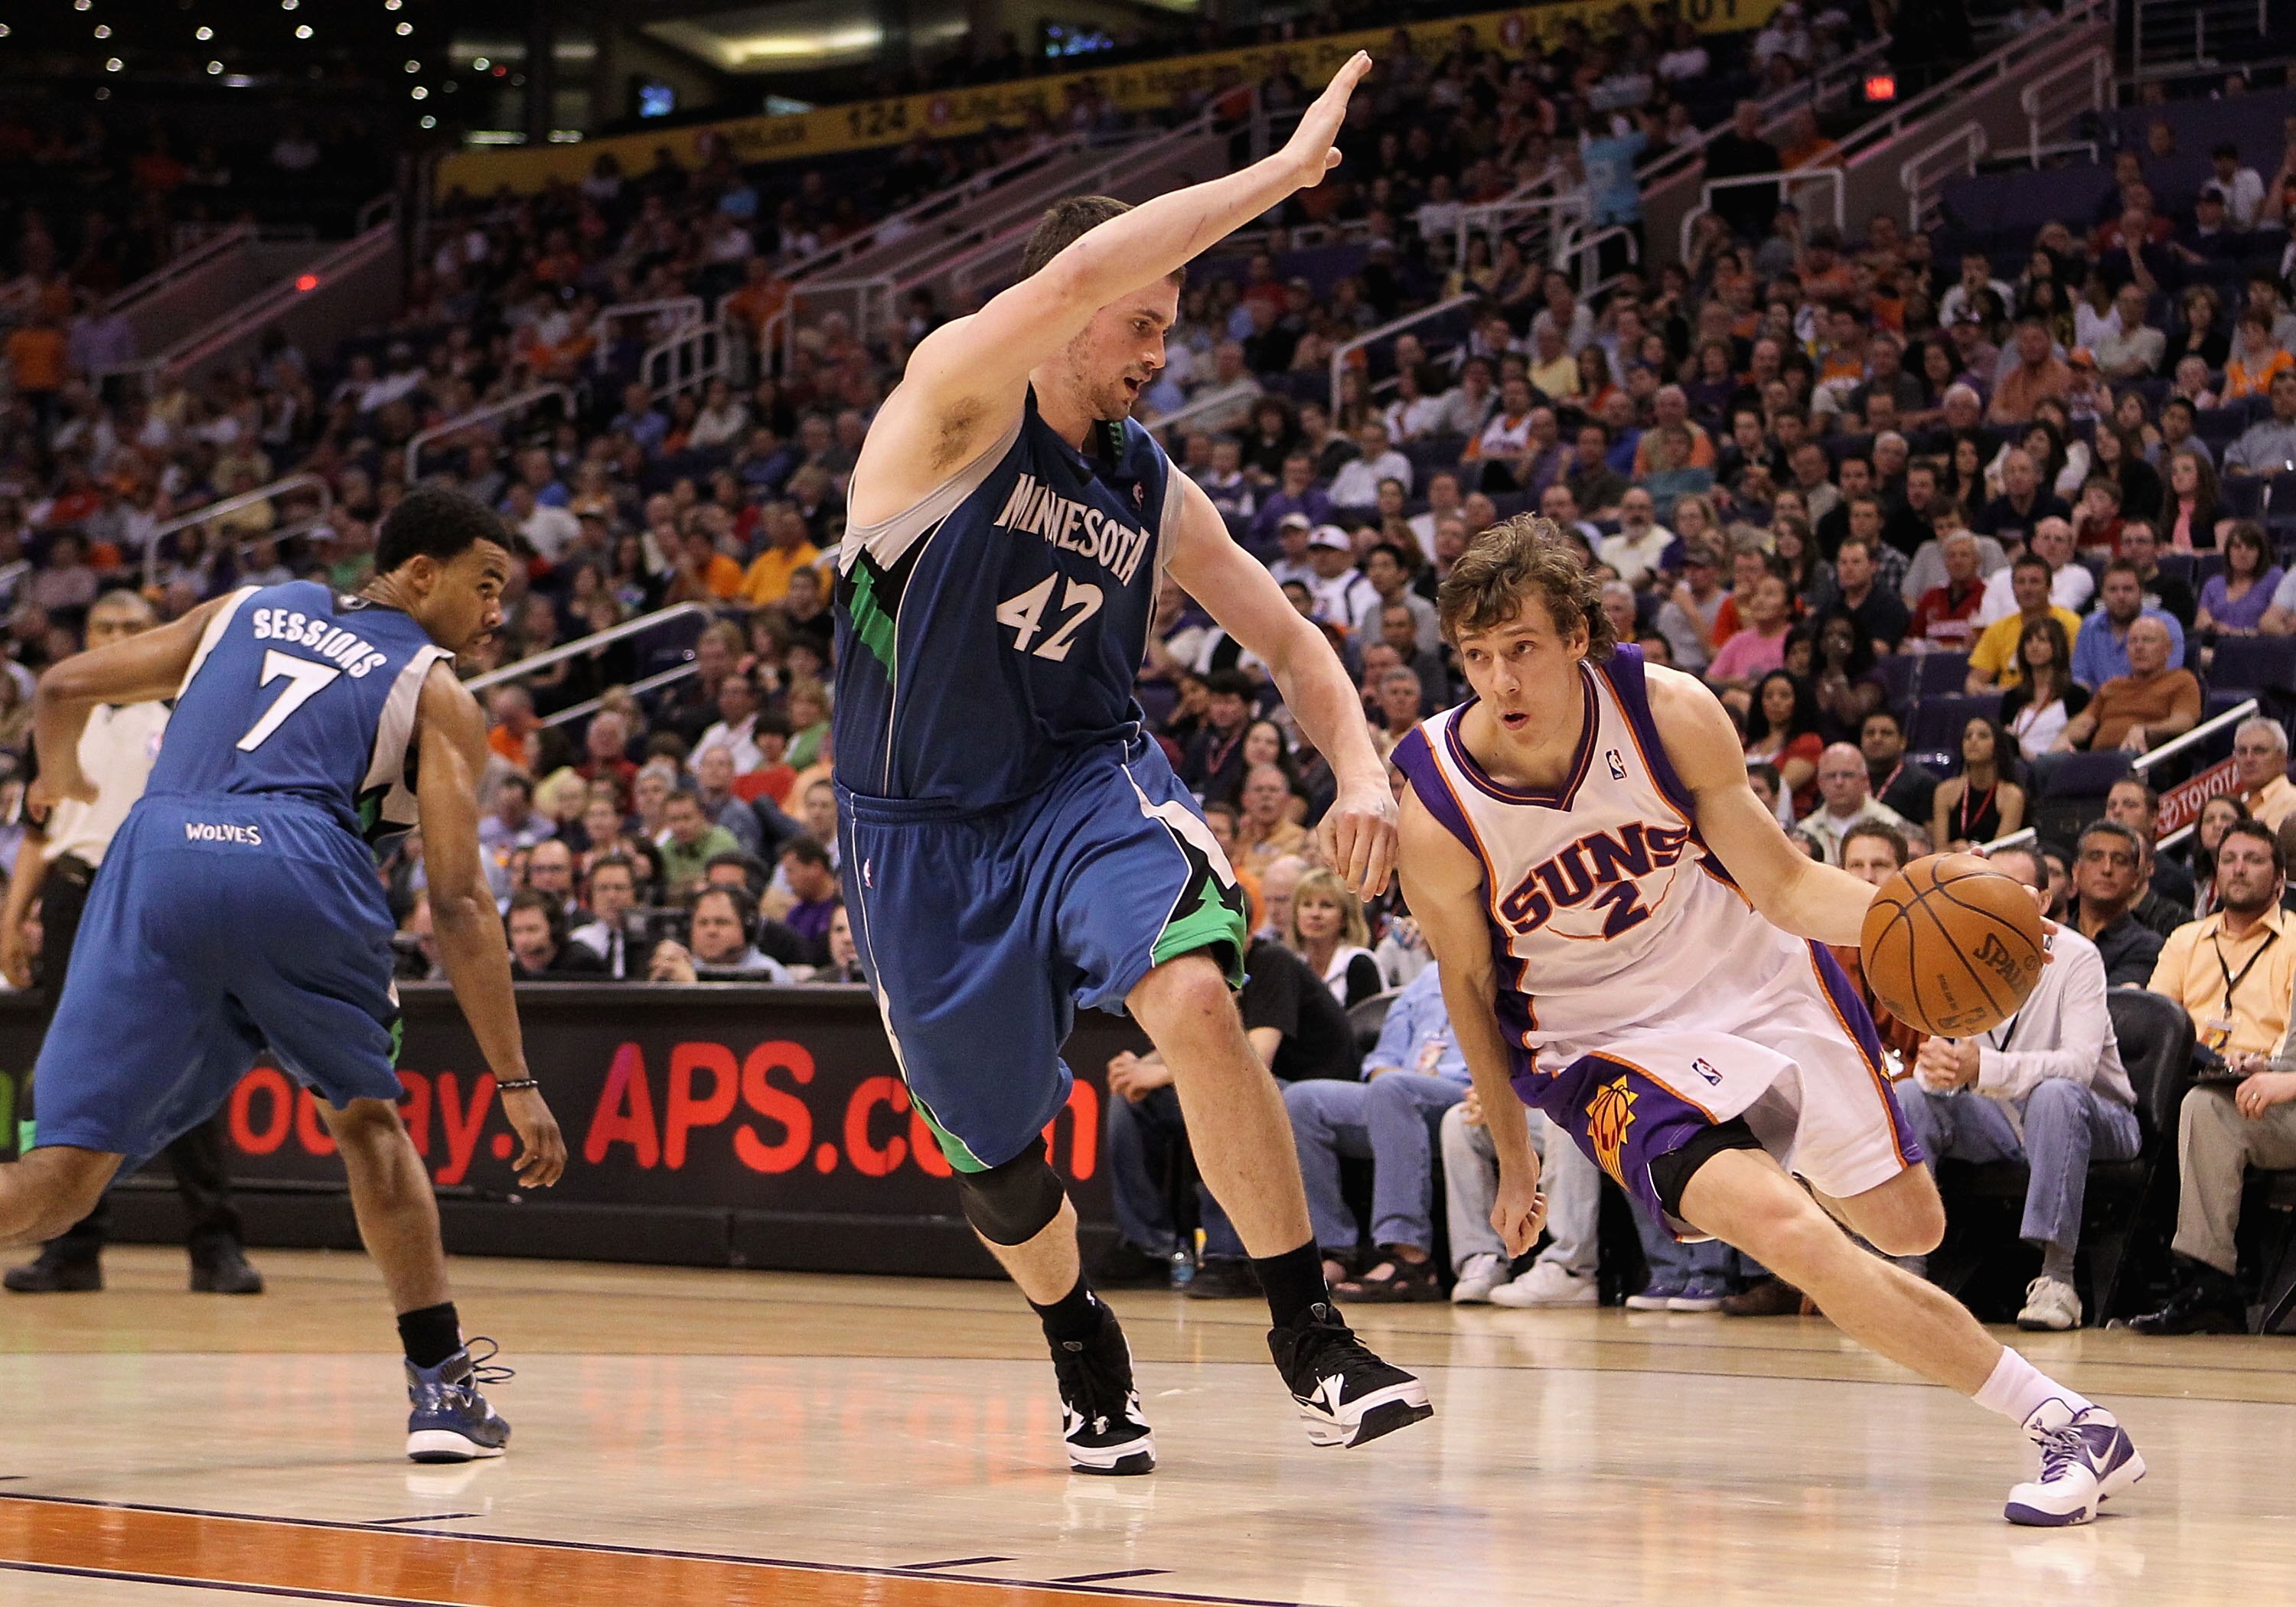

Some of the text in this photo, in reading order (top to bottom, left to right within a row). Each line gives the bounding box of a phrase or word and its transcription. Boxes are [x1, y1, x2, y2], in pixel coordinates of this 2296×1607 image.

[847, 100, 908, 139] 124
[993, 472, 1150, 587] MINNESOTA
[253, 608, 387, 679] SESSIONS
[996, 571, 1104, 663] 42
[235, 647, 342, 752] 7
[185, 822, 262, 846] WOLVES
[1499, 820, 1691, 935] SUNS
[1590, 878, 1652, 942] 2
